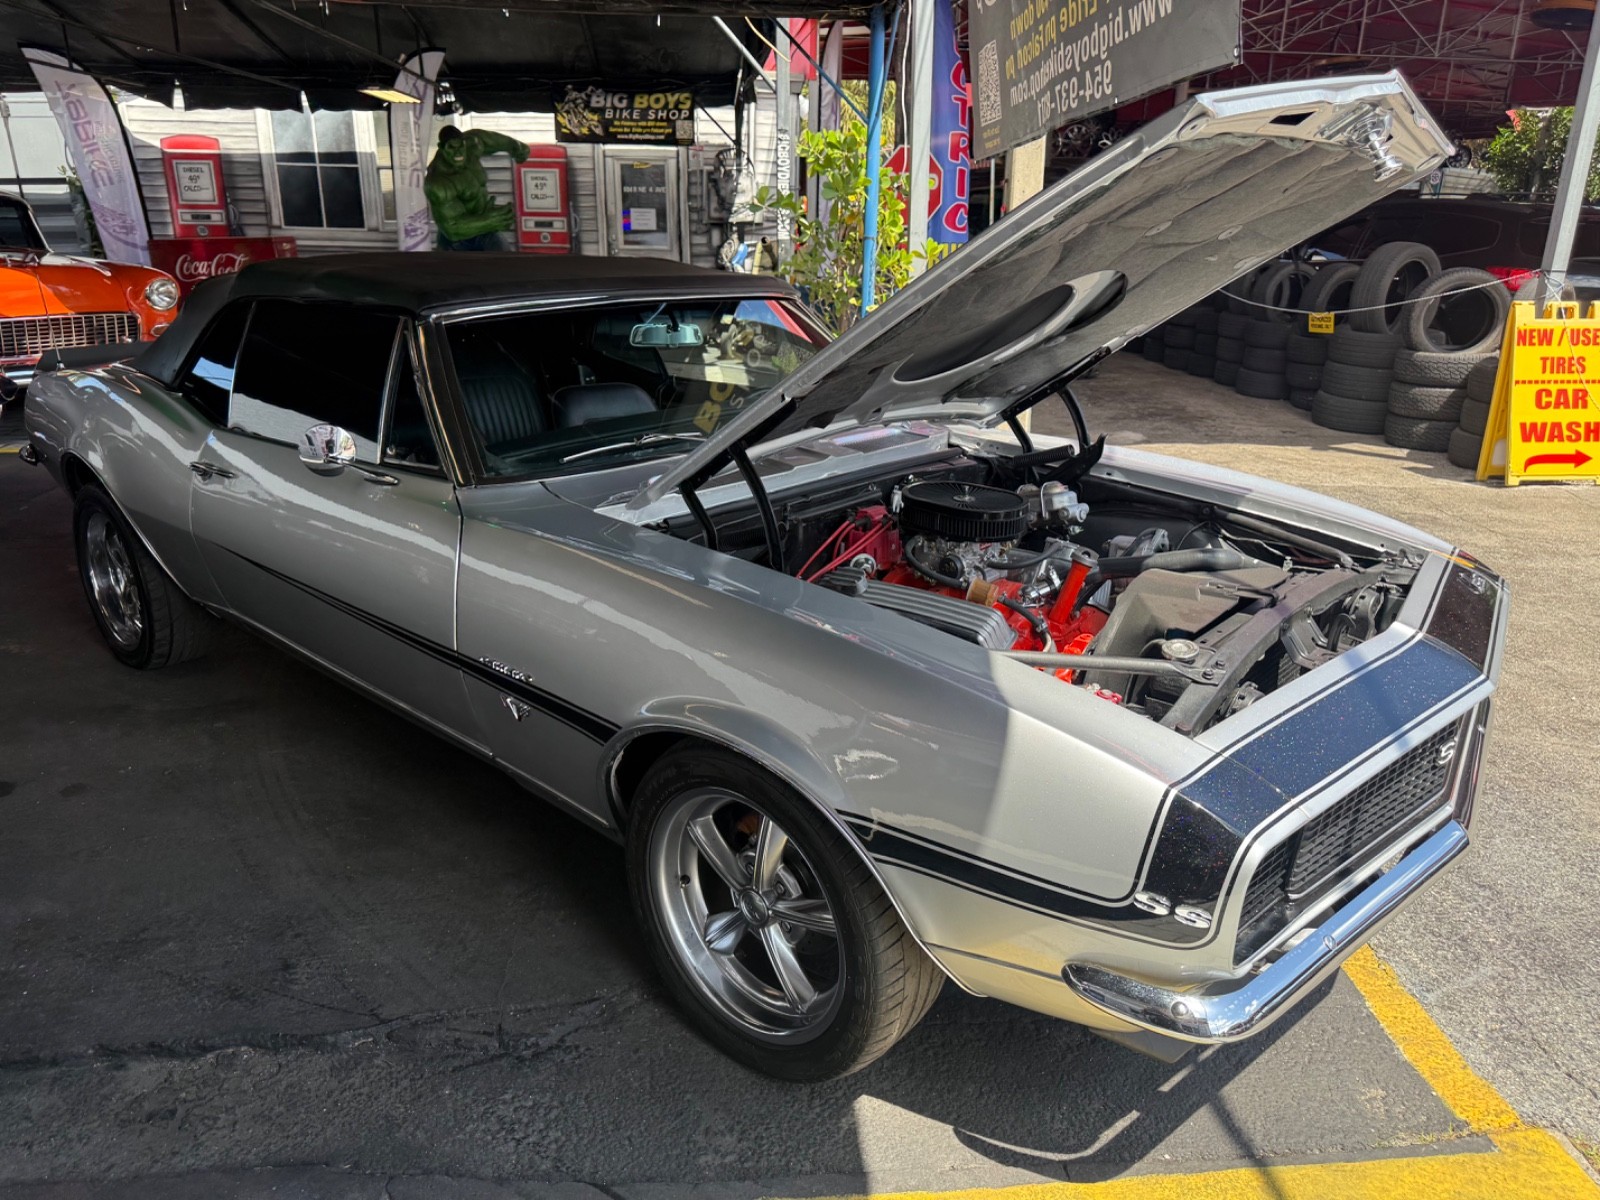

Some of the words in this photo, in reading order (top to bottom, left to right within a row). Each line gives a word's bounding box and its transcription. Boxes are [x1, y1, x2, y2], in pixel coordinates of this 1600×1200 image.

[590, 92, 628, 108] BIG
[633, 92, 693, 109] BOYS
[604, 109, 641, 120] BIKE
[647, 109, 690, 120] SHOP
[942, 30, 969, 233] CTRIC
[176, 253, 250, 281] Coca-Col
[1516, 328, 1555, 346] NEW
[1540, 356, 1586, 374] TIRES
[1534, 388, 1589, 410] CAR
[1519, 421, 1600, 443] WASH
